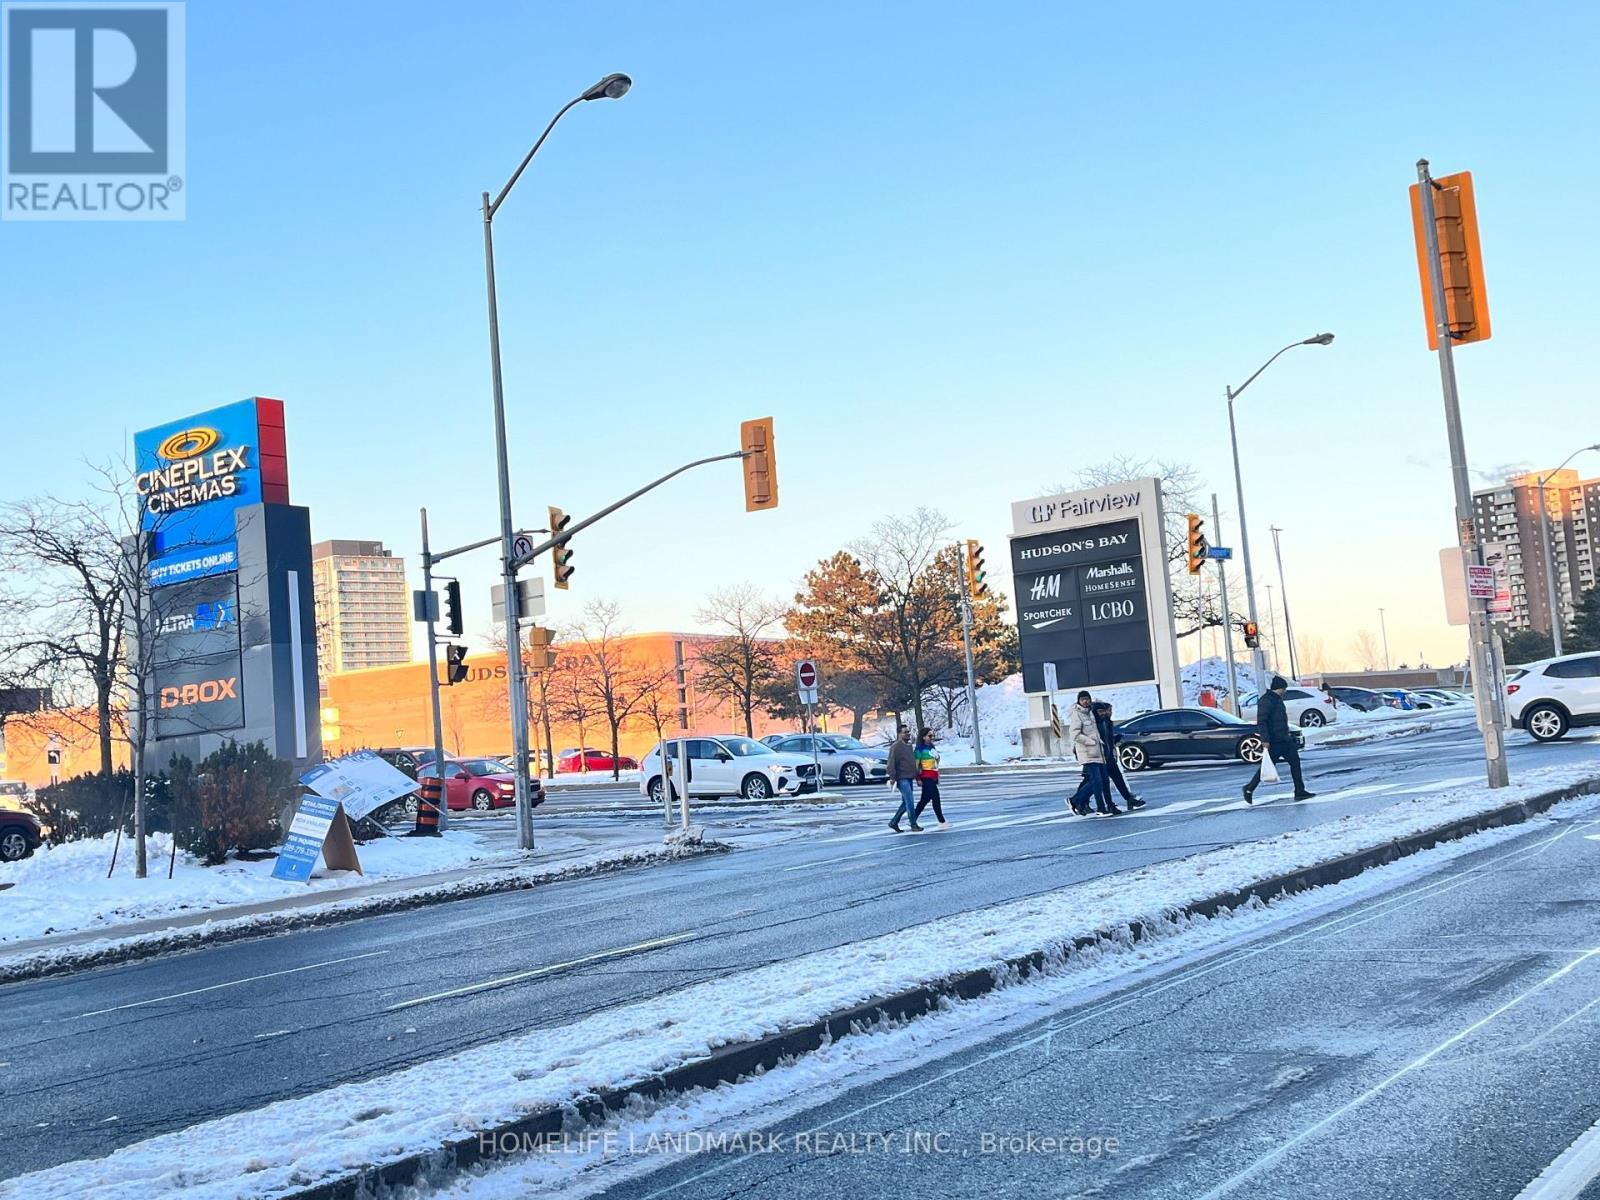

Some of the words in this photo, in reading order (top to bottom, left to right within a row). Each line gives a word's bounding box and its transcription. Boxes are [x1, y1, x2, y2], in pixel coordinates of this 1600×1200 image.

[136, 445, 246, 496] CINEPLEX
[148, 475, 236, 514] CINEMAS
[1060, 491, 1140, 518] Fairview
[1021, 539, 1095, 560] HUDSON'S
[1099, 533, 1129, 548] BAY
[168, 560, 201, 577] TICKETS
[202, 552, 234, 568] ONLINE
[1086, 562, 1134, 579] Marshalls
[1030, 573, 1061, 601] H&M
[1023, 607, 1072, 621] SPORTCHEK
[1091, 599, 1134, 621] LCBO
[160, 677, 237, 709] D-BOX
